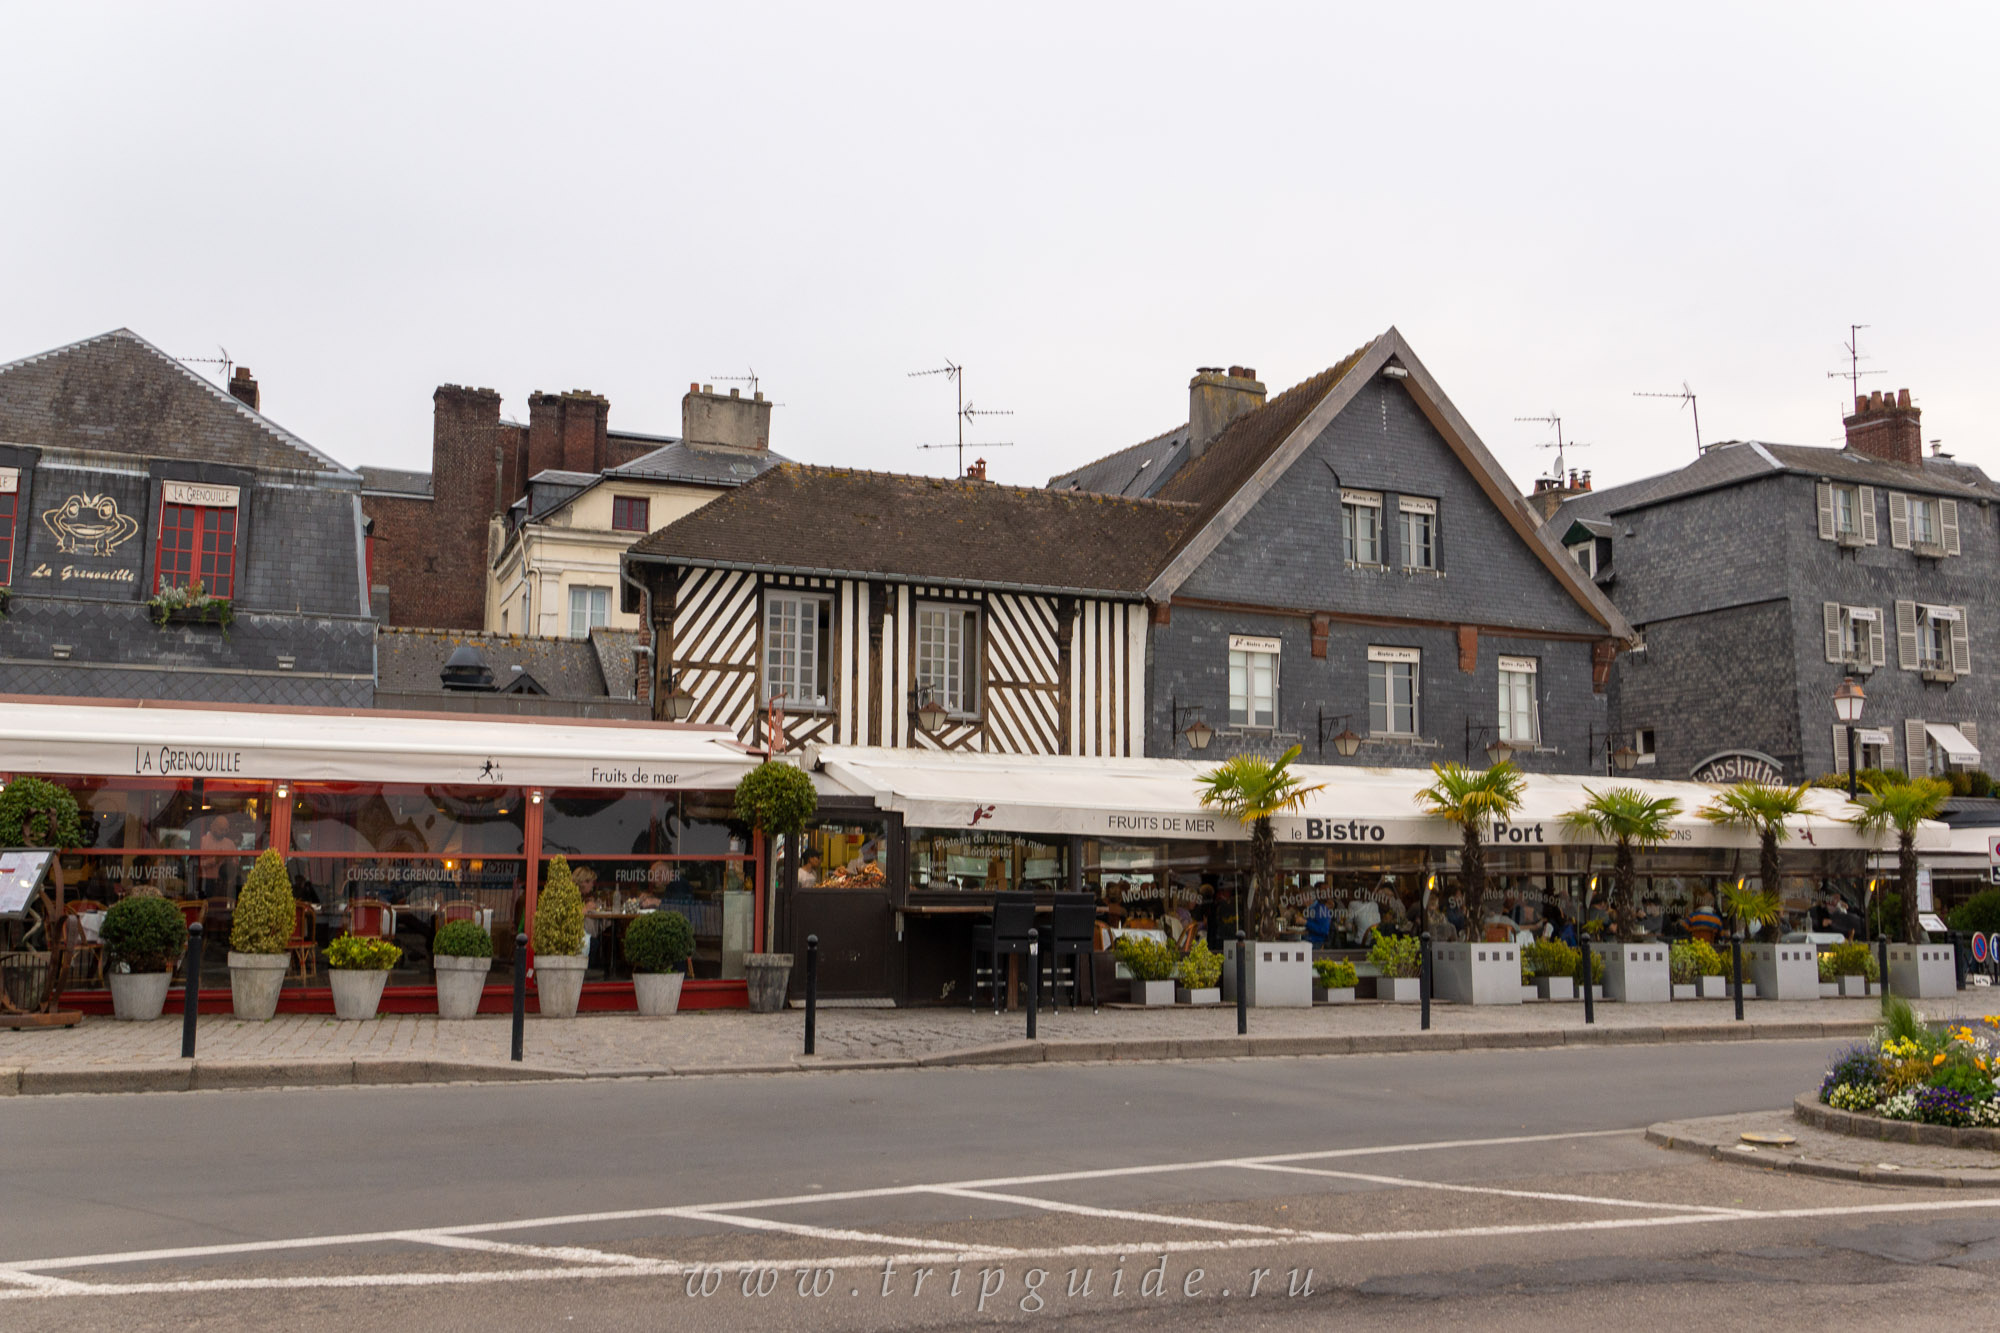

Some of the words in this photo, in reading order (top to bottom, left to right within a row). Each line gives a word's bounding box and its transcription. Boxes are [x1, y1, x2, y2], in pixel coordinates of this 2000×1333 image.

[174, 485, 184, 501] LA
[186, 486, 230, 503] GRENOUILLE
[31, 562, 52, 578] La
[60, 564, 135, 582] Grenouille
[135, 745, 152, 774] LA
[159, 746, 241, 775] GRENOUILLE
[591, 767, 628, 783] Fruits
[631, 766, 649, 783] de
[653, 773, 679, 784] mer
[1108, 815, 1158, 830] FRUITS
[1162, 817, 1181, 831] DE
[1185, 819, 1216, 833] MER
[1291, 827, 1302, 841] le
[1306, 818, 1385, 841] Bistro
[1493, 822, 1544, 843] Port
[935, 835, 971, 851] Plateau
[973, 833, 985, 845] de
[987, 832, 1012, 845] fruits
[1014, 836, 1026, 847] de
[105, 865, 124, 879] VIN
[127, 866, 142, 879] AU
[145, 865, 178, 879] VERRE
[347, 867, 385, 882] CUISSES
[387, 868, 401, 882] DE
[402, 868, 463, 882] GRENOUILLE
[615, 868, 647, 882] FRUITS
[648, 868, 660, 882] DE
[661, 869, 681, 882] MER
[1121, 885, 1166, 904] Moules
[1169, 885, 1203, 905] Frites
[1302, 908, 1316, 919] de
